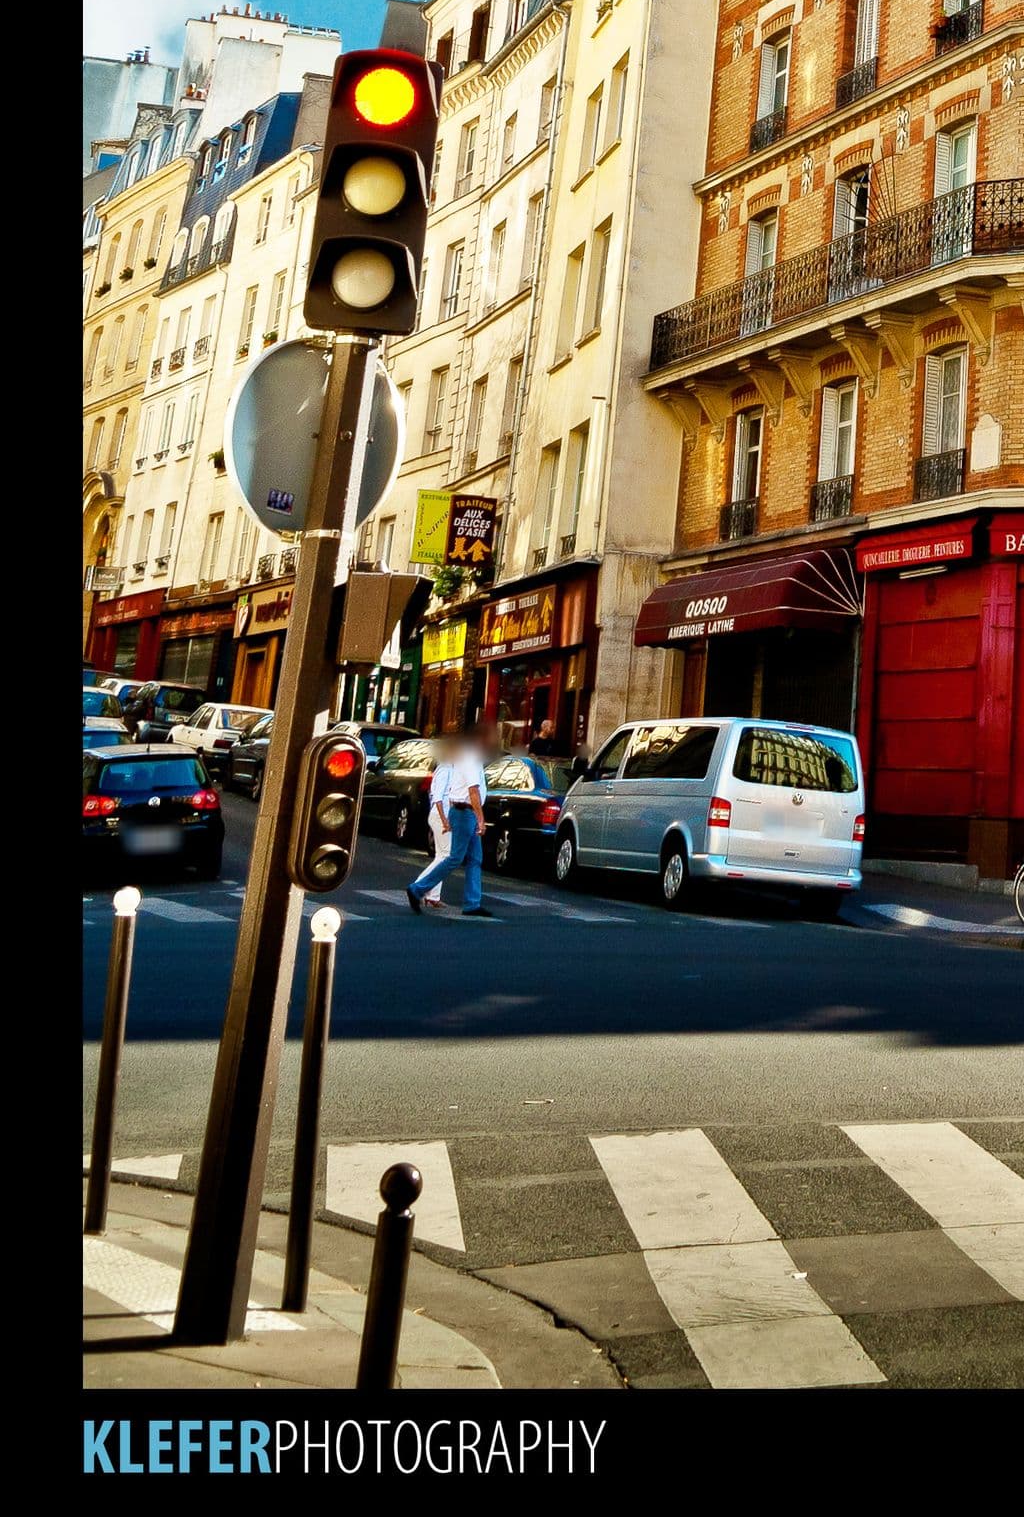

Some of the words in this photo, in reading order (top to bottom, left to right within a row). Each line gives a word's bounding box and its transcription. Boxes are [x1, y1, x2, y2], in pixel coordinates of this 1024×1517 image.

[455, 499, 494, 511] TRAITEUR
[464, 508, 484, 519] AUX
[457, 526, 487, 538] D'ASIE
[863, 549, 900, 569] QUINCAILLERIE
[933, 540, 965, 557] PEINTURES
[685, 596, 728, 618] QOSQO
[668, 622, 705, 639] AMERIQUE
[708, 618, 734, 634] LATINE
